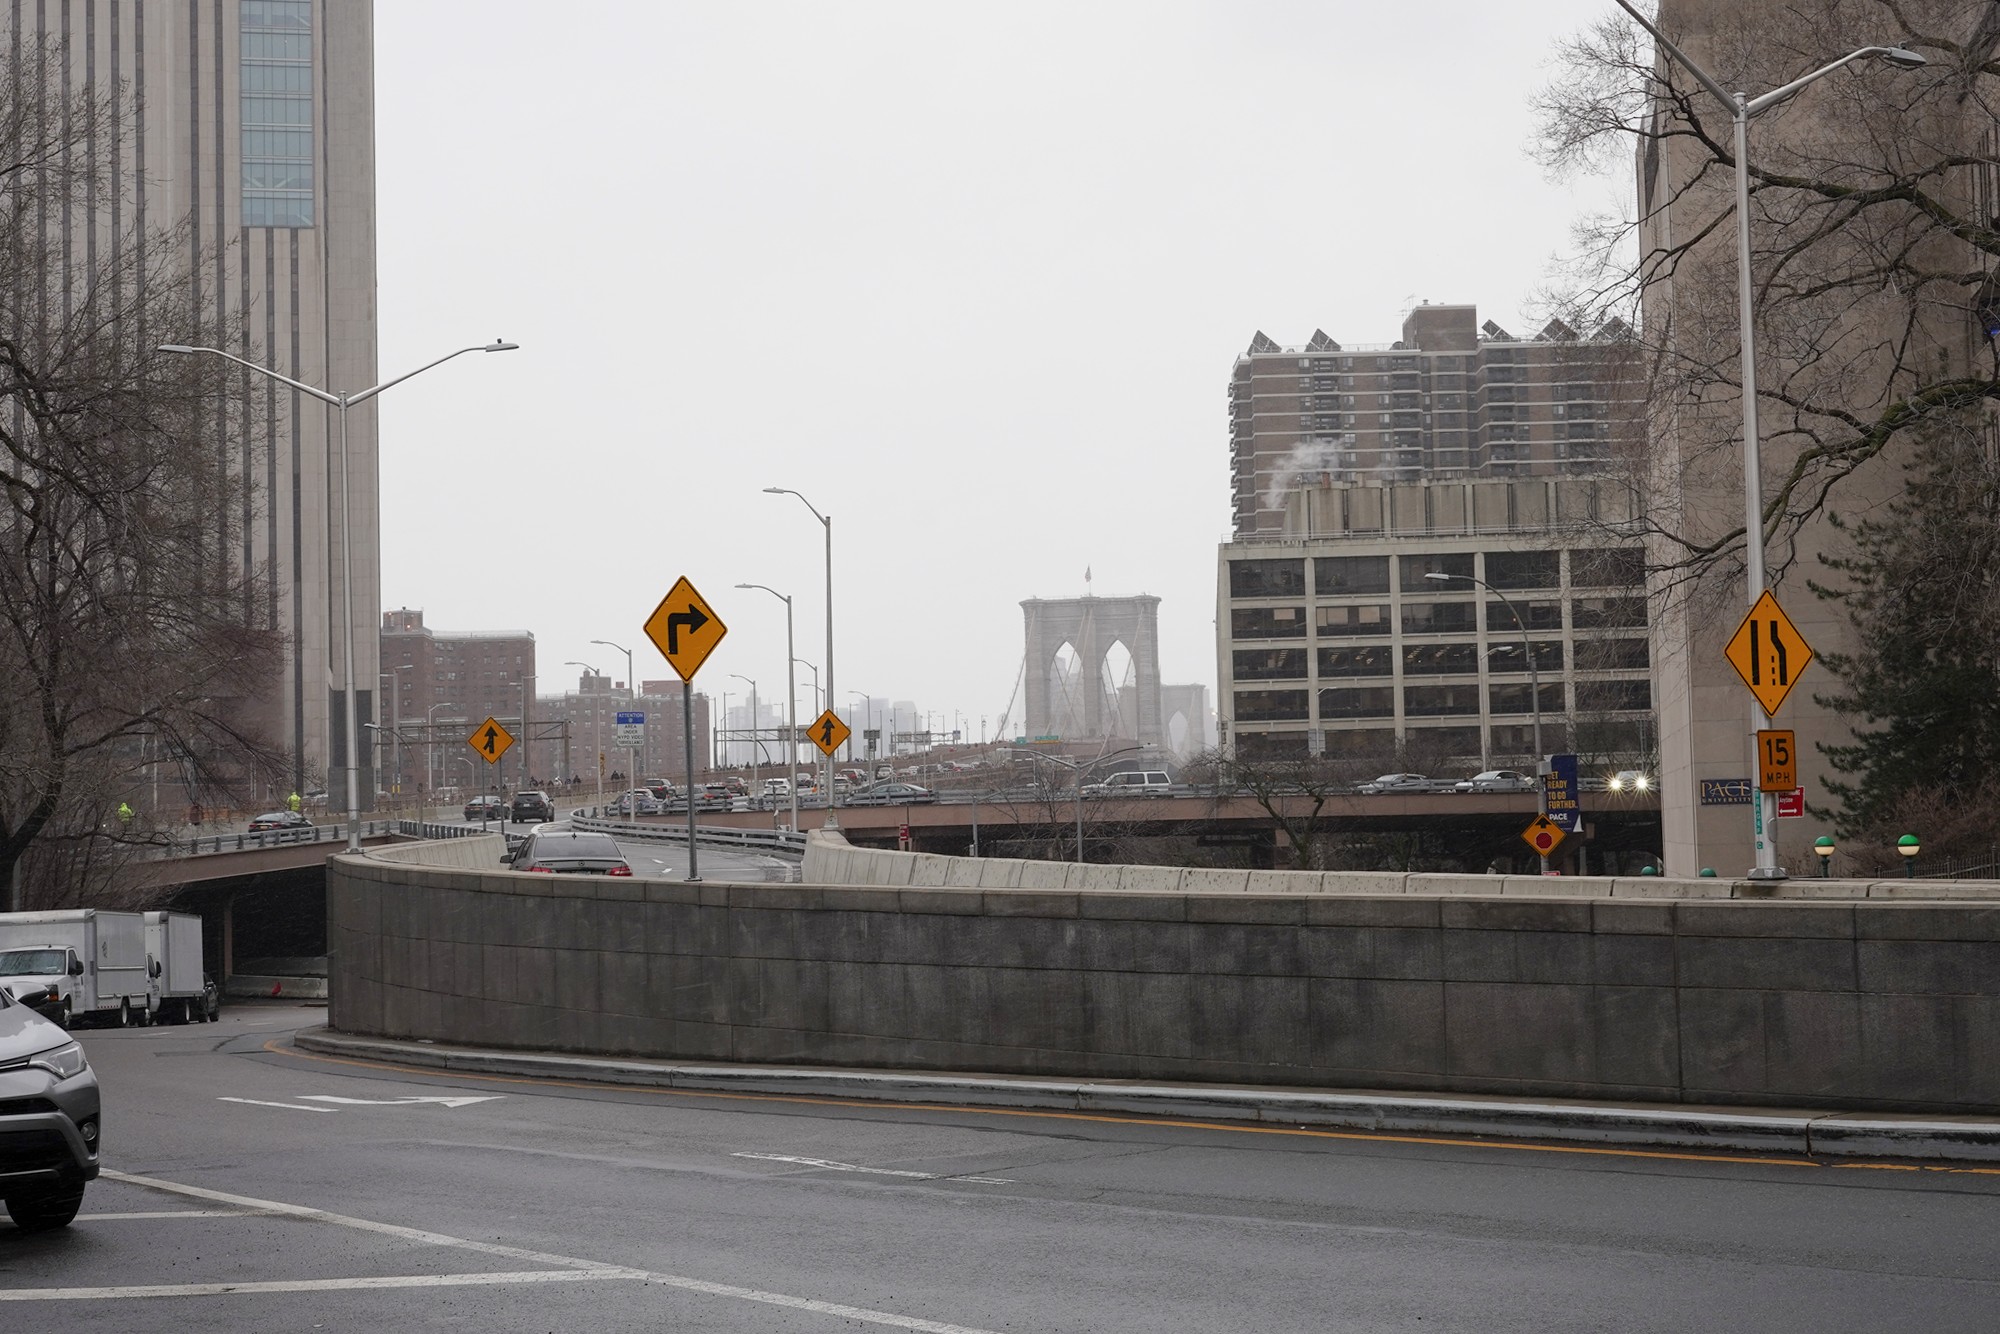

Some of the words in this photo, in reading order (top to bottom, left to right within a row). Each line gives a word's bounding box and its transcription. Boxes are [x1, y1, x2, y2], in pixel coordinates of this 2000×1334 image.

[1766, 738, 1789, 766] 15
[1547, 780, 1567, 789] READY
[1701, 781, 1751, 797] PACE
[1548, 791, 1557, 800] TO
[1557, 791, 1567, 800] GO
